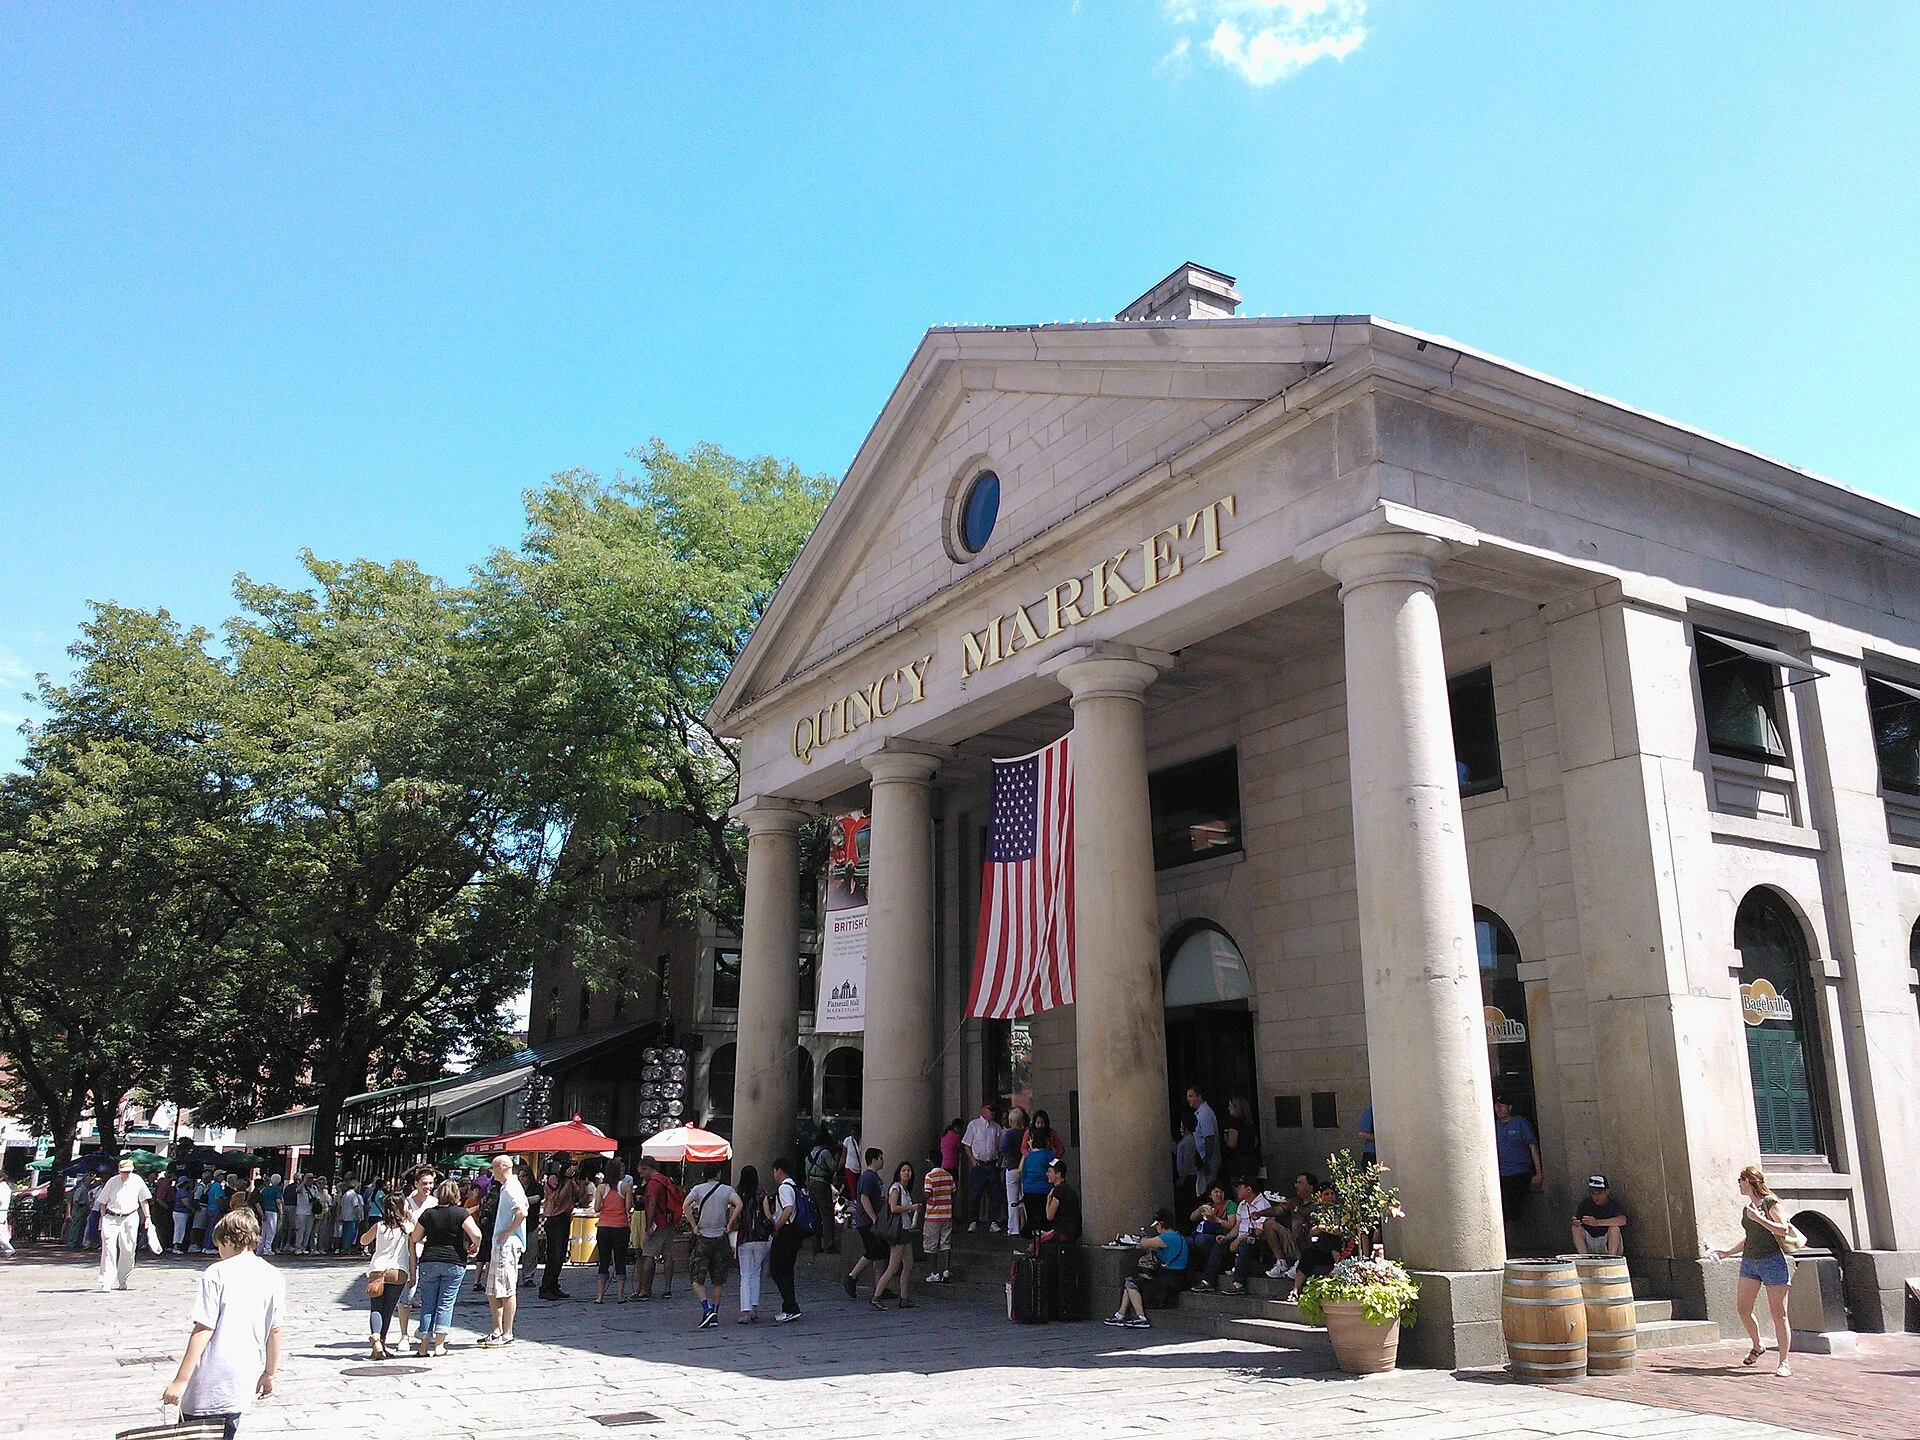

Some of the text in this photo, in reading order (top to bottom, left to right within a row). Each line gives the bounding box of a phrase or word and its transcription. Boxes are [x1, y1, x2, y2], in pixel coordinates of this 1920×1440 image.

[792, 495, 1236, 765] QUINCY MARKET
[834, 918, 864, 933] BRITISH
[1743, 995, 1790, 1014] Bagelville
[1486, 1021, 1522, 1037] elville
